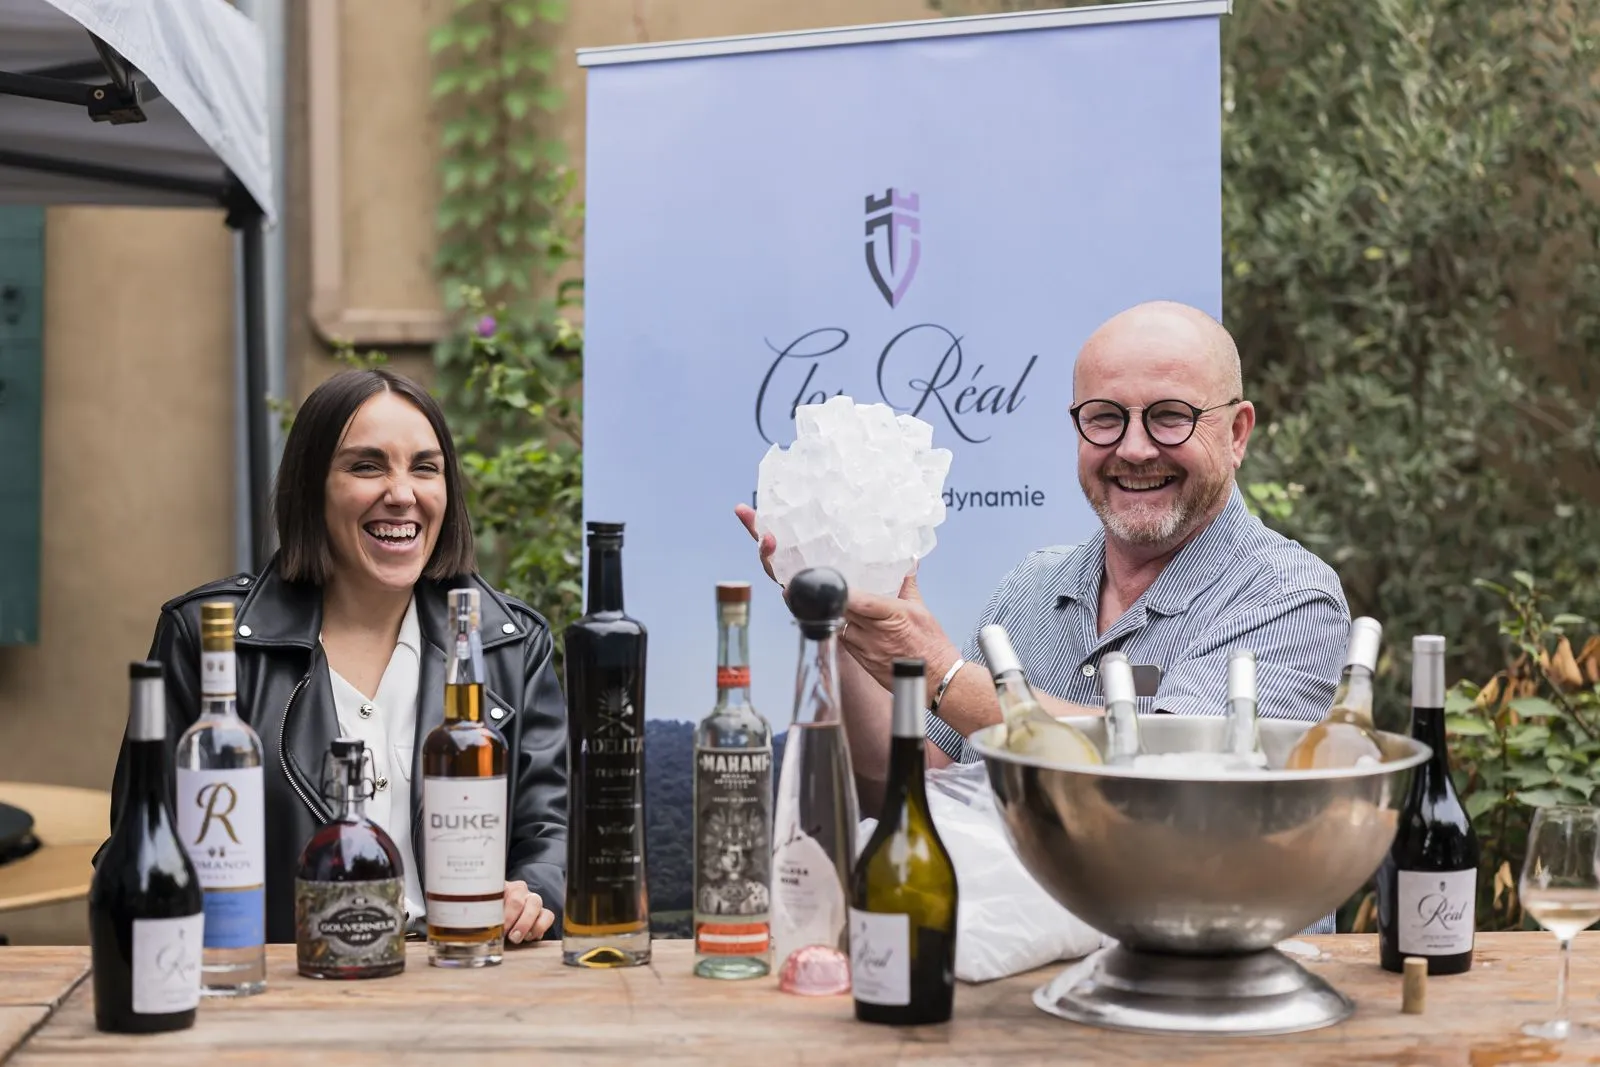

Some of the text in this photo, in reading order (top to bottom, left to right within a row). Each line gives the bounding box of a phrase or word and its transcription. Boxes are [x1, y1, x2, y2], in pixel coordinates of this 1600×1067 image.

[756, 323, 1038, 450] Clo Réal
[942, 484, 1045, 511] dynamie
[581, 738, 643, 753] ADELITA
[195, 782, 241, 845] R
[431, 813, 499, 829] DUKE
[195, 860, 251, 870] OMANOV
[1417, 893, 1467, 930] Réal
[320, 920, 395, 933] GOUVERNEUR
